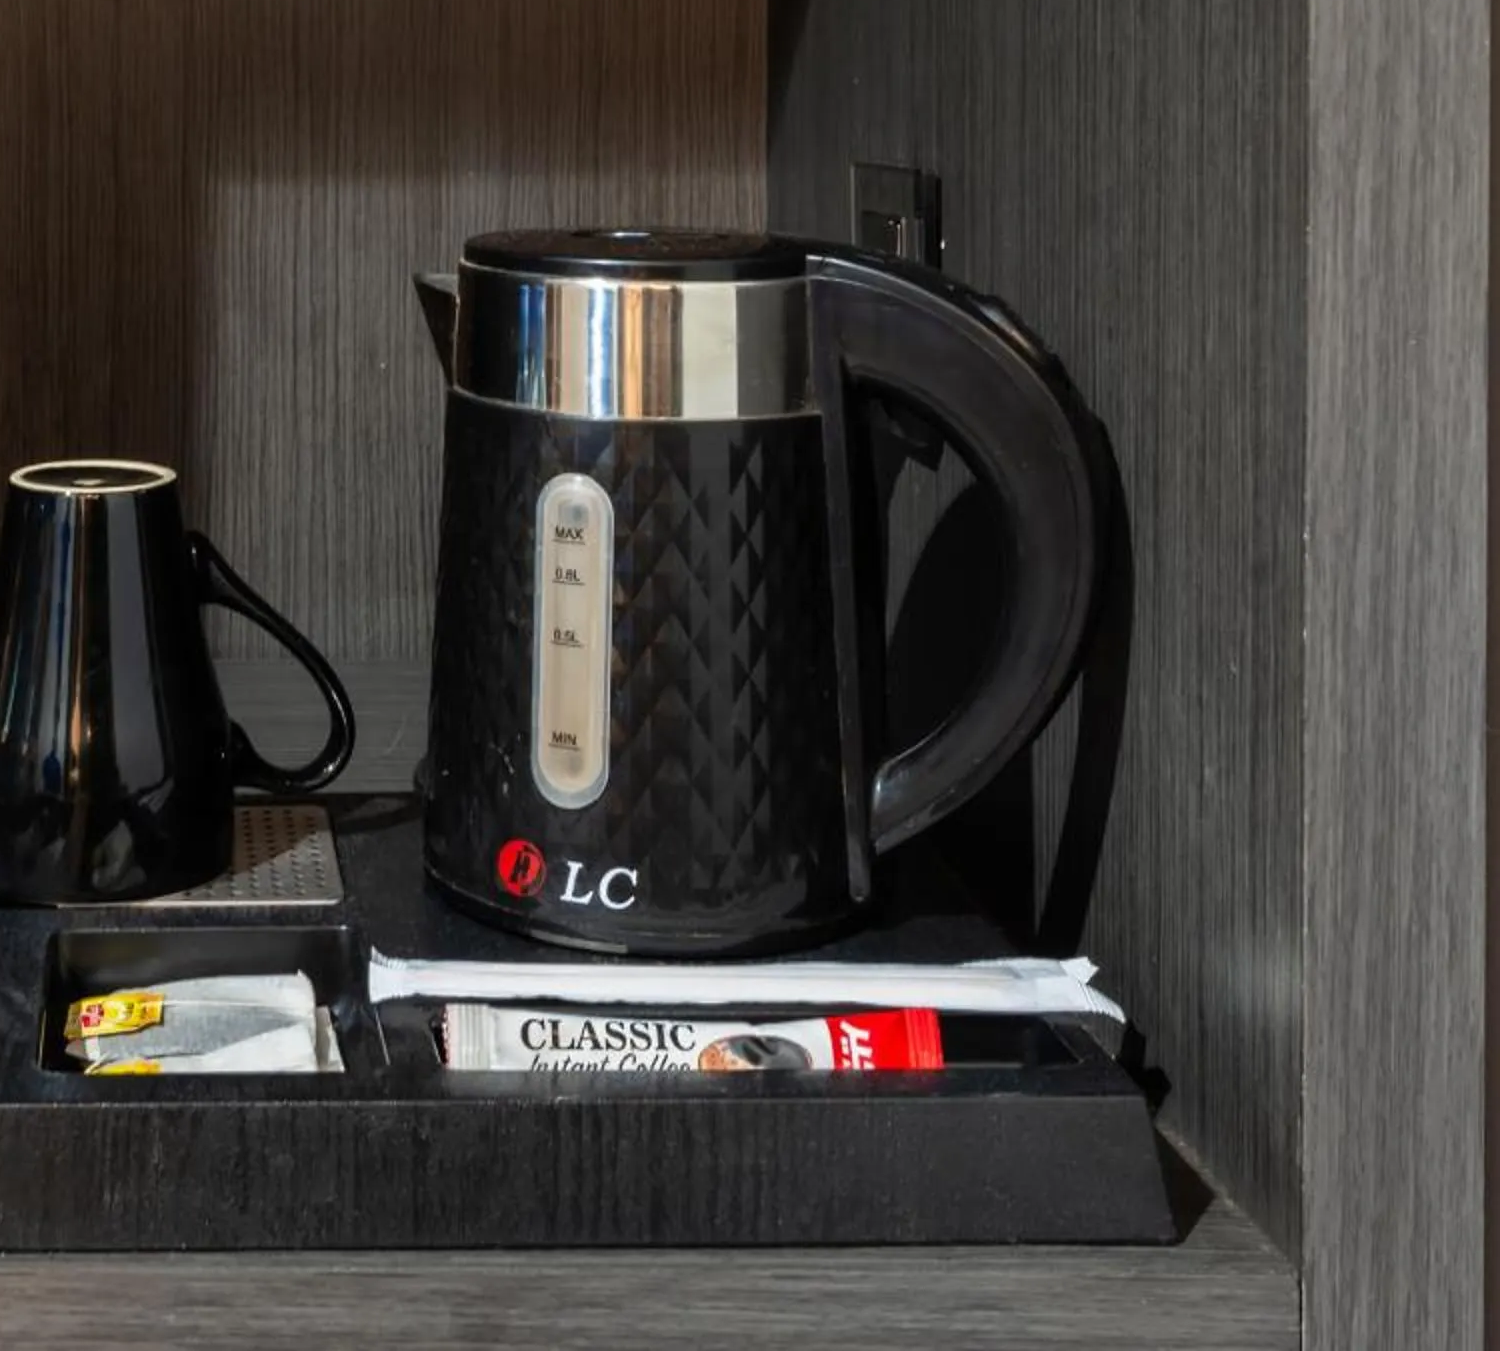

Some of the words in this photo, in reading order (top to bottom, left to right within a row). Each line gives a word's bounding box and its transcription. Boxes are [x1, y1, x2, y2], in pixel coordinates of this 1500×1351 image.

[555, 525, 584, 540] MAX
[551, 731, 577, 746] MIN
[520, 1018, 696, 1052] CLASSIC
